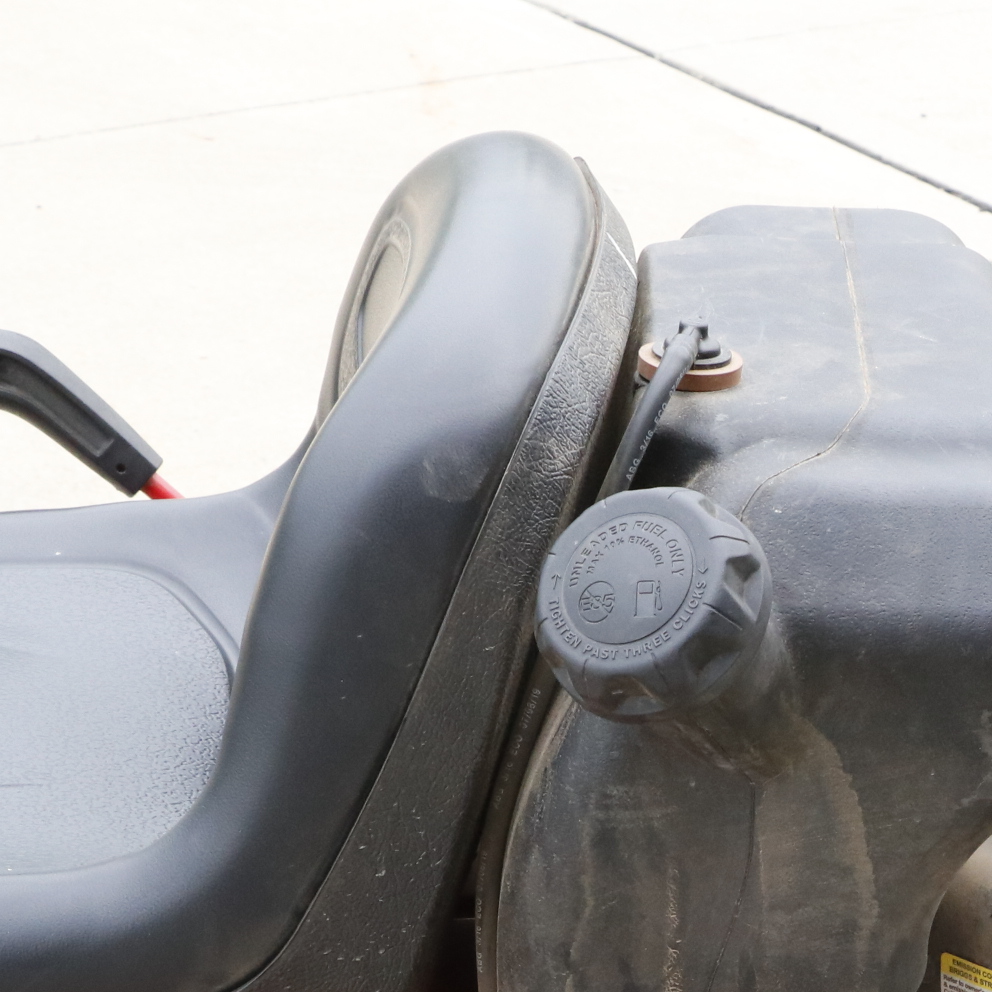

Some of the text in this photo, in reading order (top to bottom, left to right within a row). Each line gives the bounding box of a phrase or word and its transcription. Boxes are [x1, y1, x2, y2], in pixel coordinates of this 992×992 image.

[569, 520, 685, 588] UNLEADED FUEL ONLY
[586, 535, 665, 574] MAX 10% ETHANOL
[549, 580, 707, 661] TIGHTEN PAST THREE CLICKS
[944, 974, 958, 984] Refer
[949, 966, 973, 982] BRIGGS
[974, 976, 978, 984] &
[952, 958, 981, 976] EMISSION
